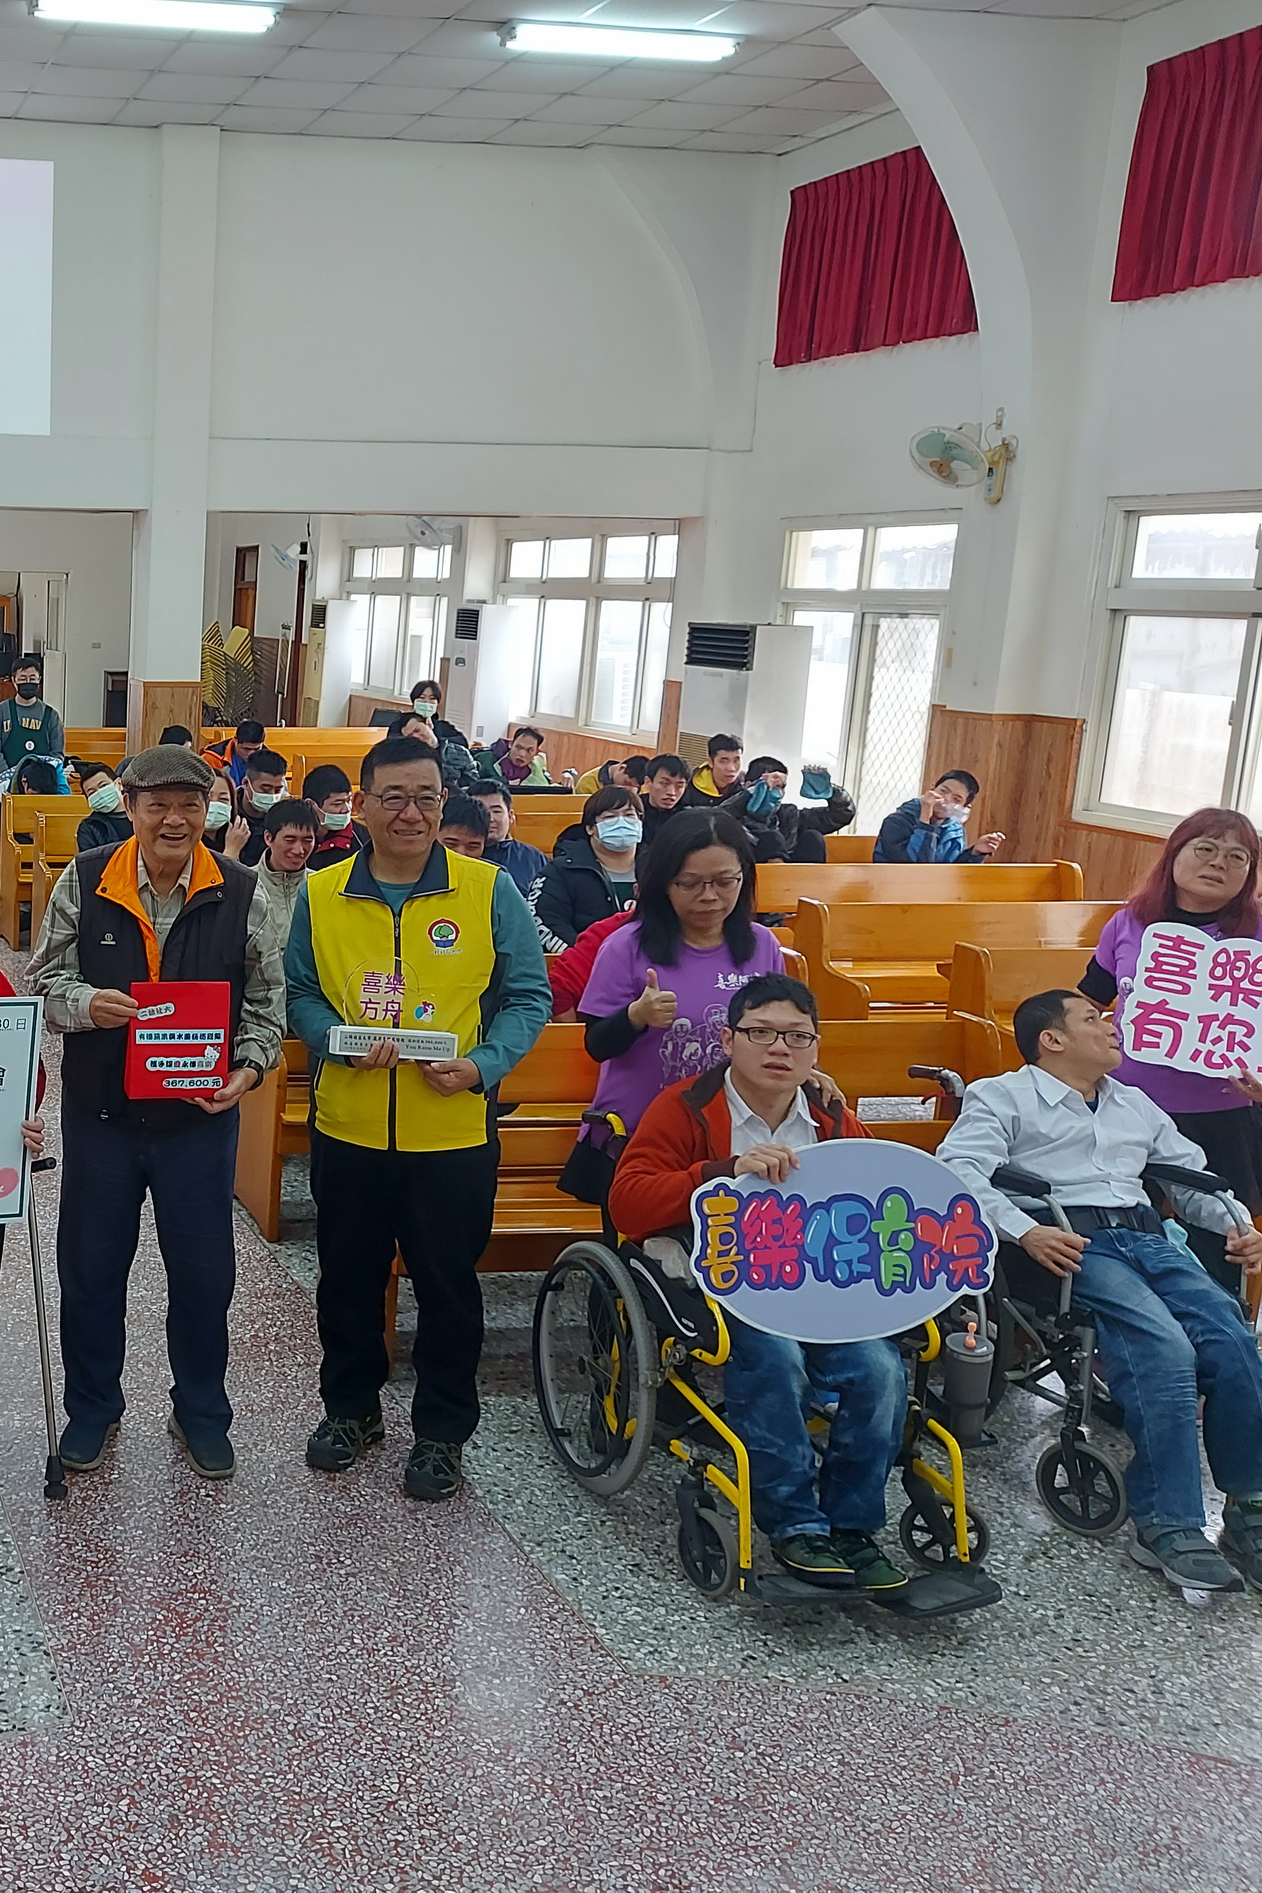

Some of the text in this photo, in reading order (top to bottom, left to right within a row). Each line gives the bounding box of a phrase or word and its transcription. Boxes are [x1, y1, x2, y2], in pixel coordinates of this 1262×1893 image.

[22, 717, 42, 731] NAV
[361, 971, 406, 996] 喜樂
[1144, 932, 1262, 1010] 喜樂
[359, 998, 403, 1023] 方舟
[1130, 998, 1256, 1070] 有您
[700, 1189, 989, 1290] 喜樂保育院
